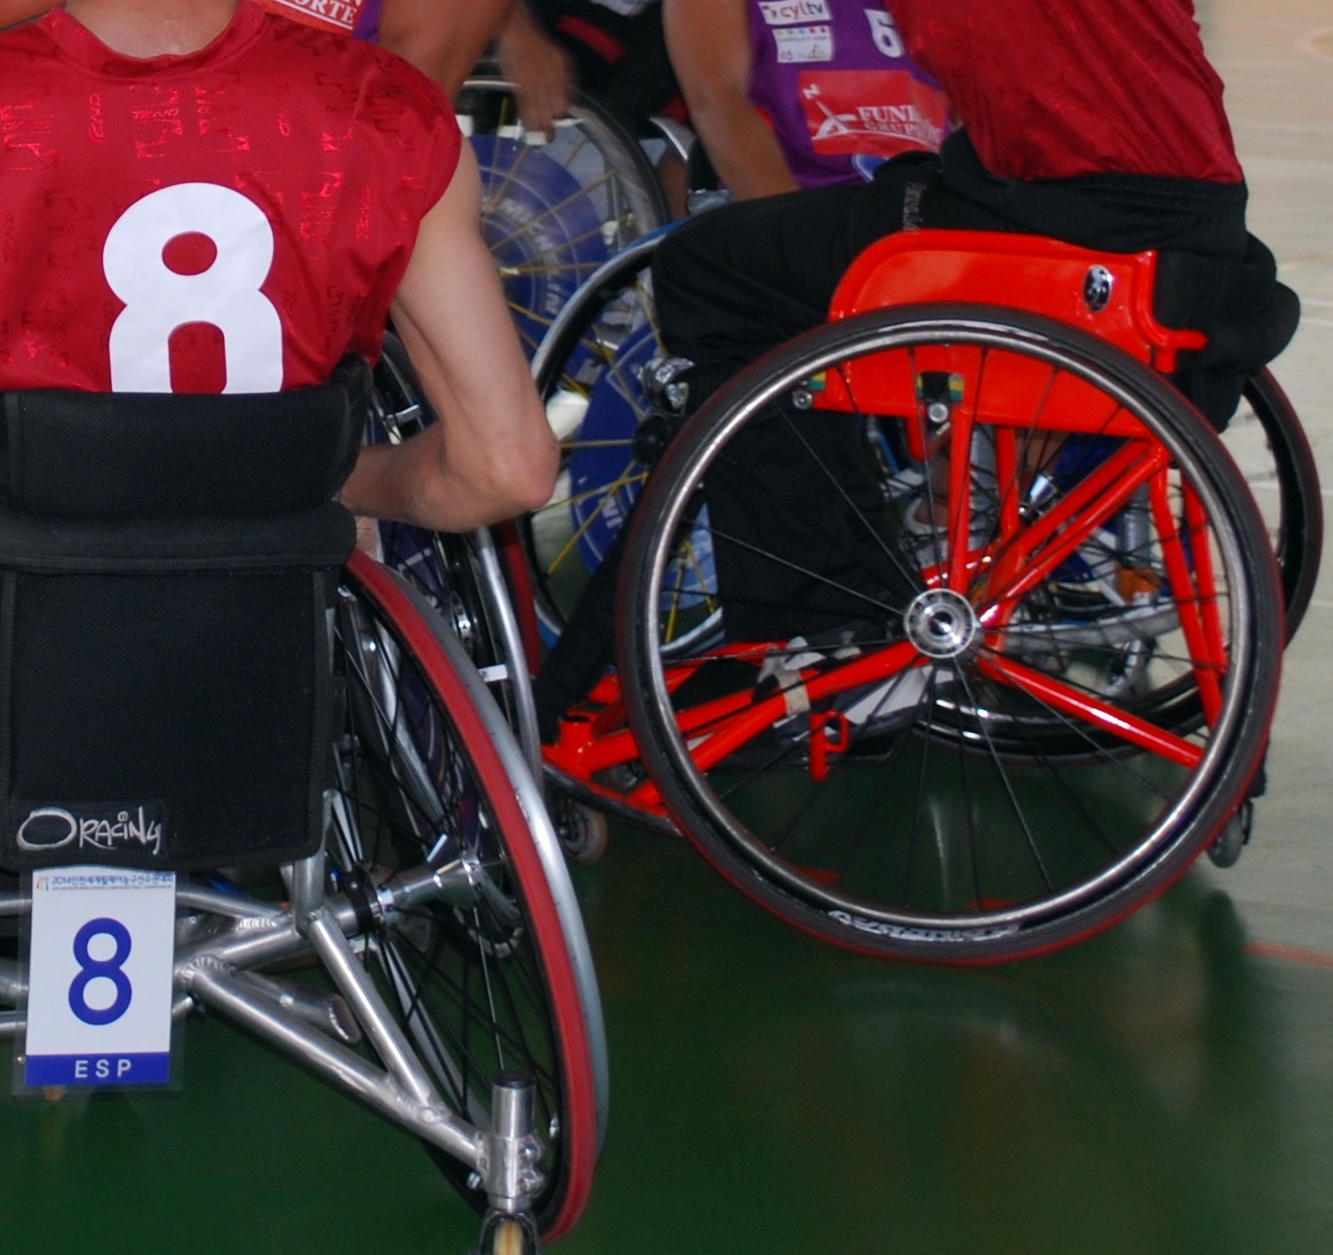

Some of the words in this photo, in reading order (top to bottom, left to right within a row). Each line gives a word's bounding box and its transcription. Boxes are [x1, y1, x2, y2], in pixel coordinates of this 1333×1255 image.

[864, 8, 904, 58] 6
[102, 182, 284, 395] 8
[68, 917, 132, 1026] 8
[75, 1059, 132, 1079] ESP
